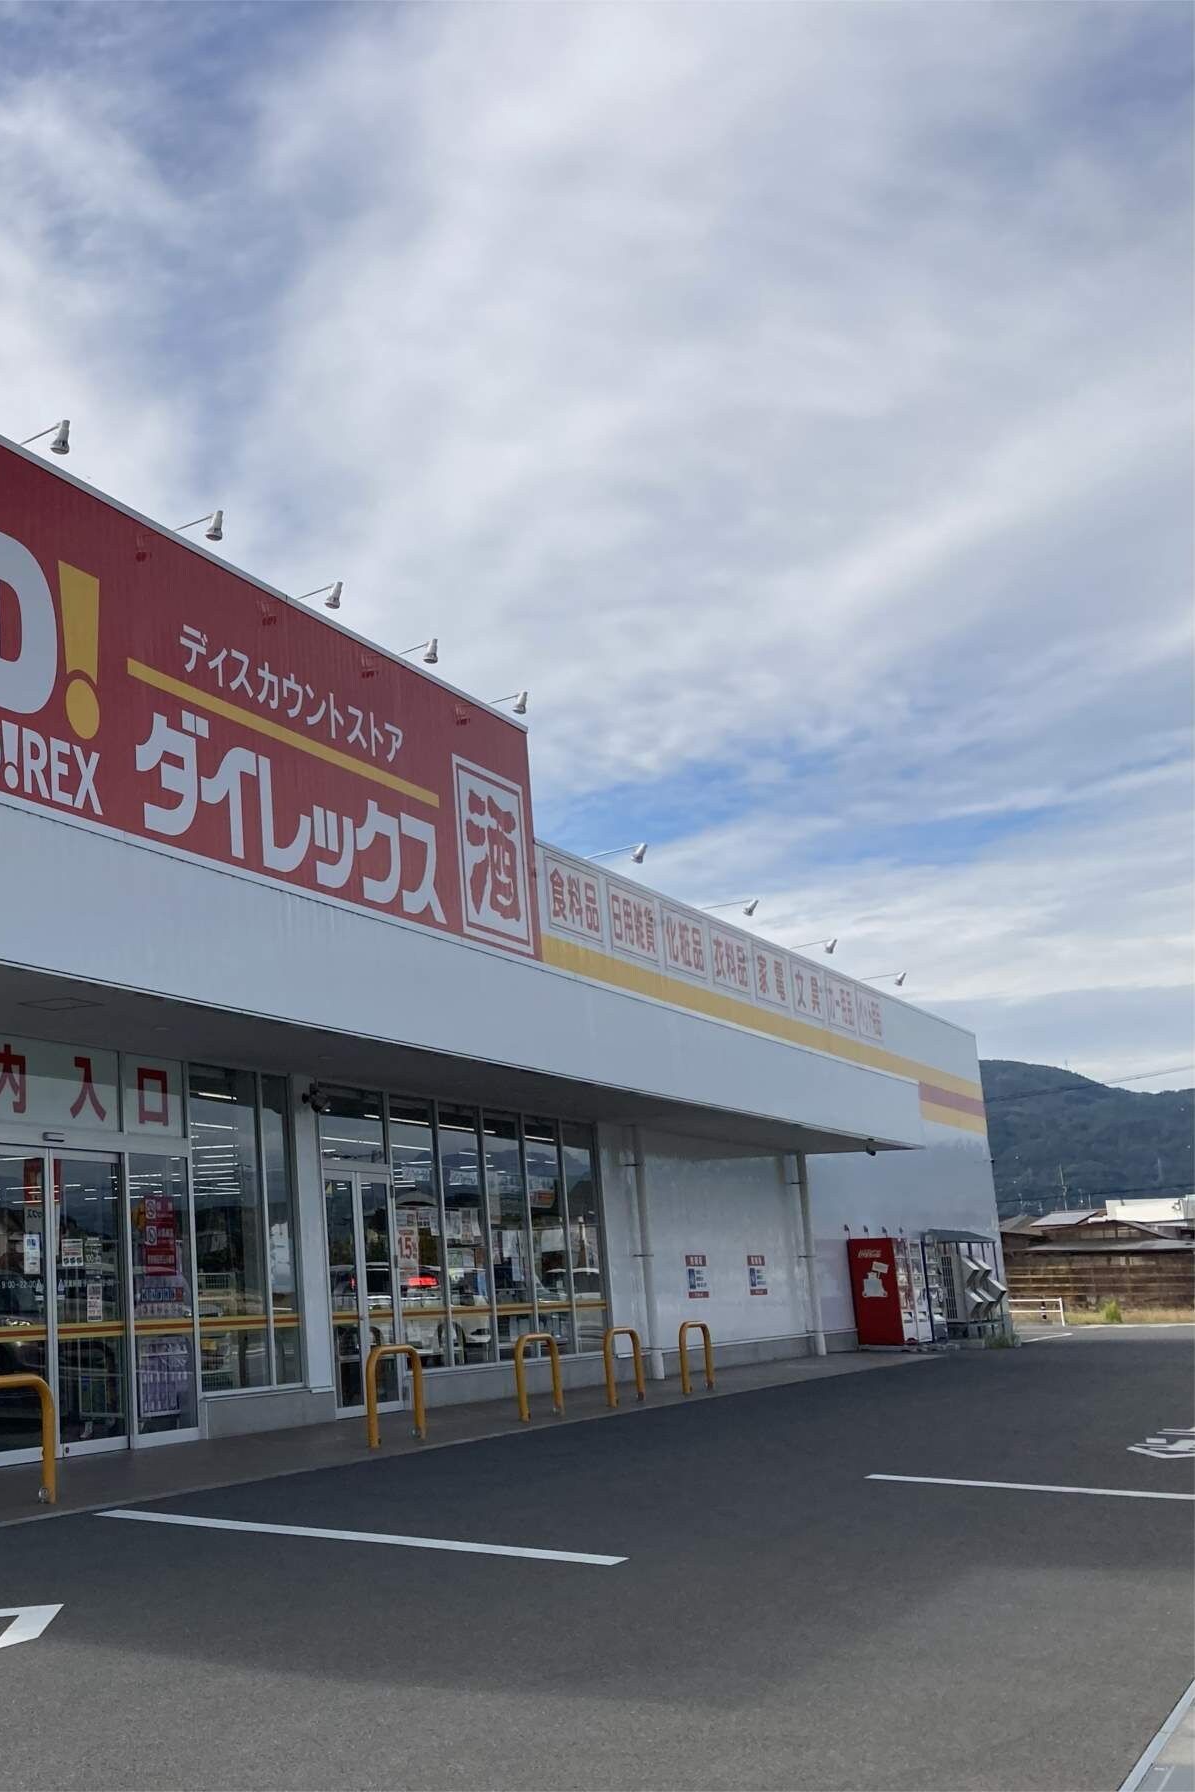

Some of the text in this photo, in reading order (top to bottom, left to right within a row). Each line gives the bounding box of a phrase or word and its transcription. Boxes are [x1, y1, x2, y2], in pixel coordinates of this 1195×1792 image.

[179, 622, 404, 763] ディスカウントストア
[136, 712, 446, 924] ダイレックス
[466, 789, 521, 922] 酒
[549, 868, 600, 934] 食料品
[610, 893, 656, 954] 日用雑貨
[665, 915, 705, 972] 化粧品
[712, 936, 749, 987] 衣料品
[756, 954, 787, 1002] 家電
[794, 970, 821, 1014] 文具
